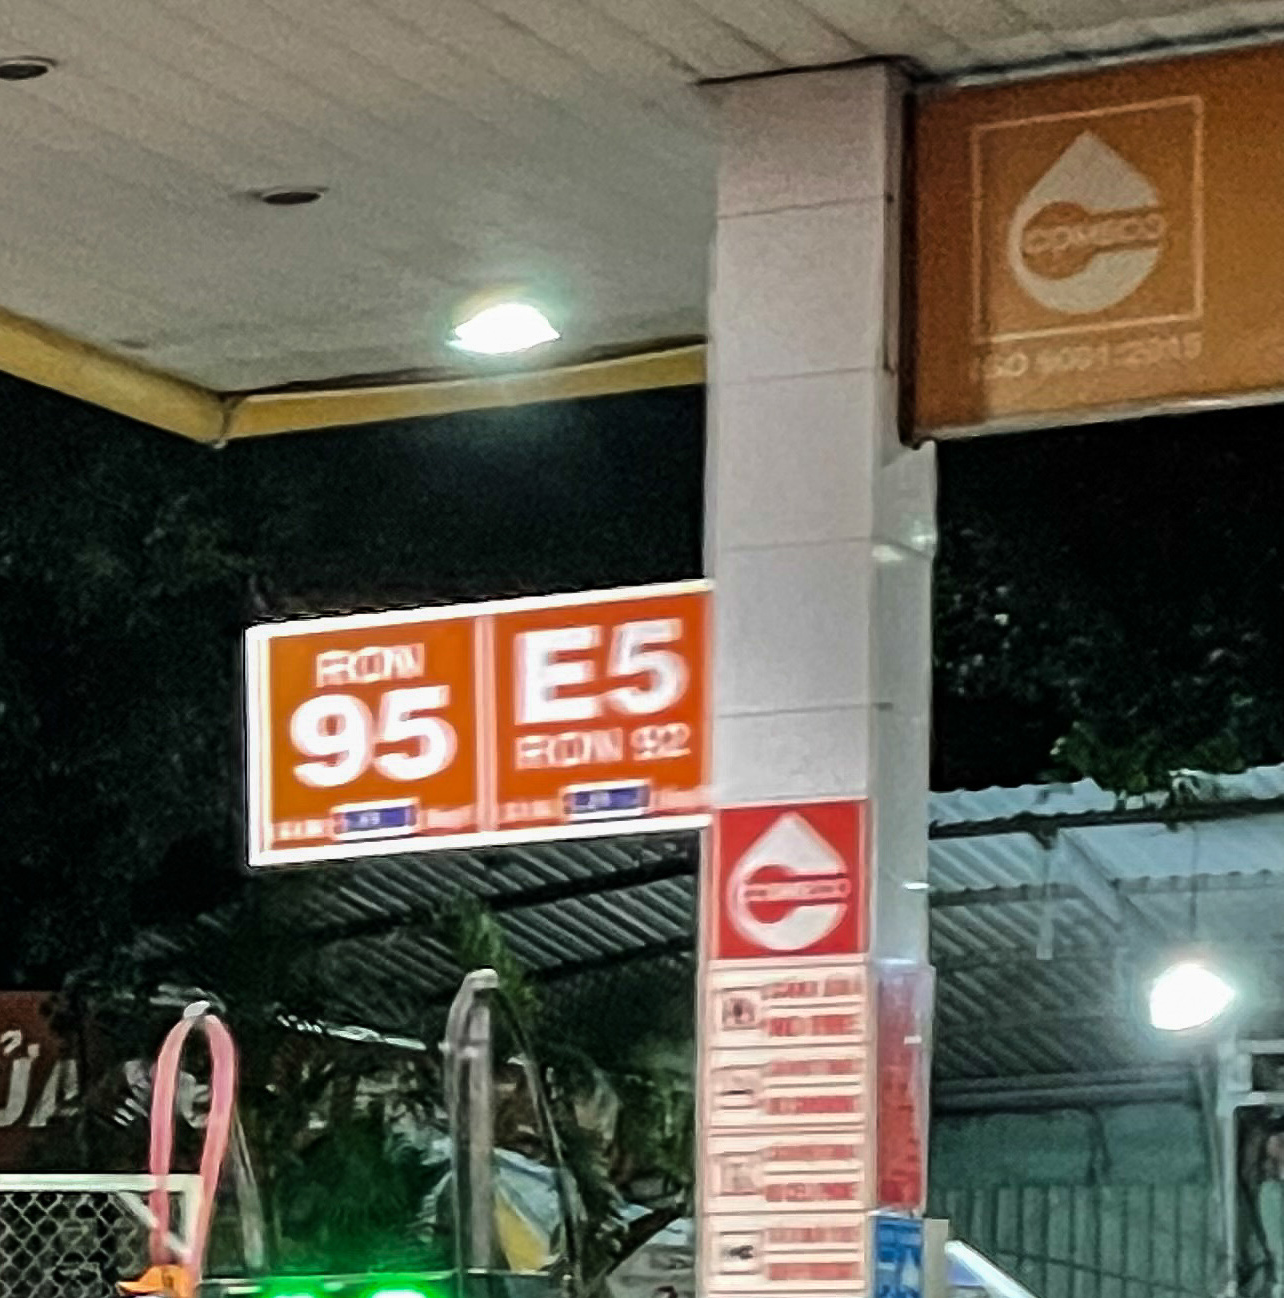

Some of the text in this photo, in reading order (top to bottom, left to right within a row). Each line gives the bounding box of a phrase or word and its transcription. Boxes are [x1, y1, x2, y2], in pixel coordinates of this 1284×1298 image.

[316, 643, 425, 688] RON
[515, 618, 690, 725] E5
[289, 685, 458, 788] 95
[515, 723, 692, 770] RON 92
